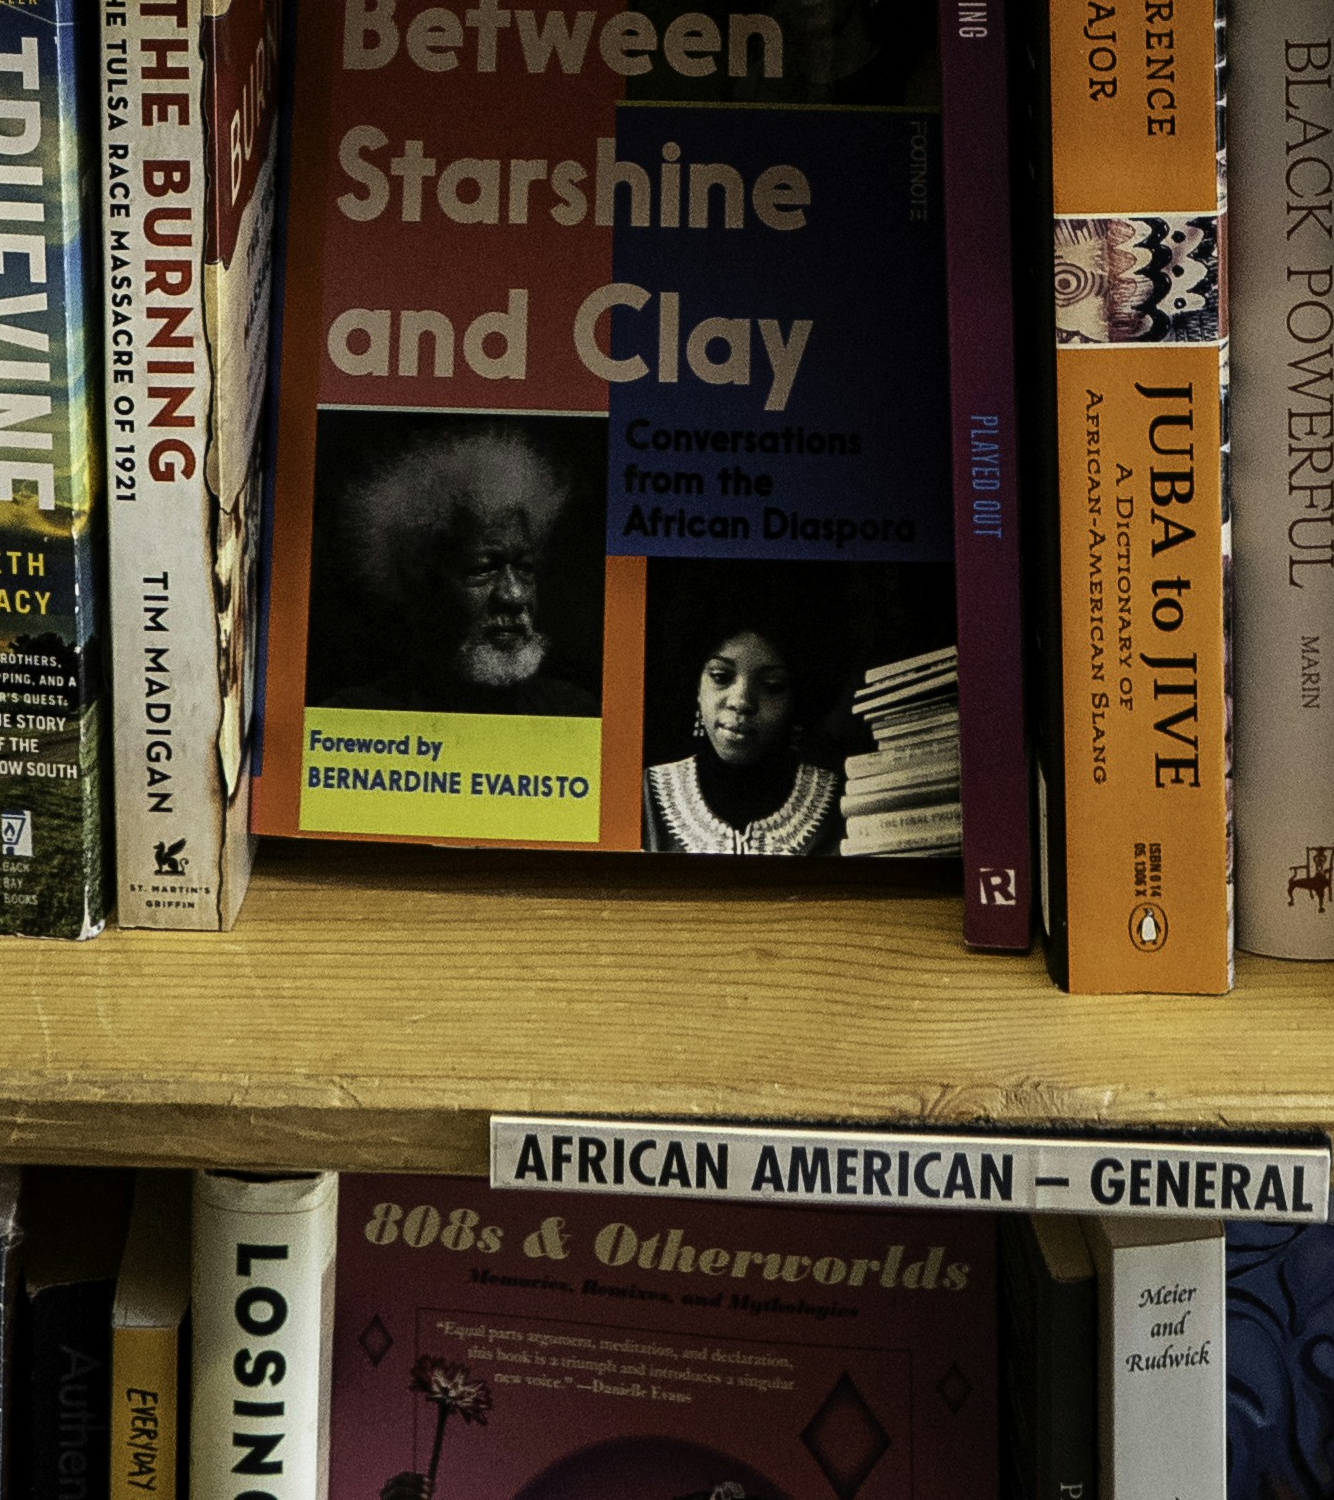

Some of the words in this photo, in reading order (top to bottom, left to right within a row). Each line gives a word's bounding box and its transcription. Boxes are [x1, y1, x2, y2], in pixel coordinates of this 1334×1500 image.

[336, 125, 809, 229] Starshine
[143, 160, 195, 481] BURNING
[327, 289, 528, 379] and
[572, 283, 812, 410] Clay
[143, 572, 168, 631] TIM
[16, 715, 67, 732] STORY
[145, 649, 175, 814] MADIGAN
[310, 730, 410, 755] Foreword
[417, 736, 442, 761] by
[308, 766, 461, 794] BERNARDINE
[471, 773, 589, 798] EVARISTO
[515, 1135, 728, 1189] AFRICAN
[751, 1146, 1014, 1201] AMERICAN
[1090, 1158, 1313, 1213] GENERAL
[1150, 1310, 1191, 1338] and
[1125, 1345, 1209, 1372] Rudwick
